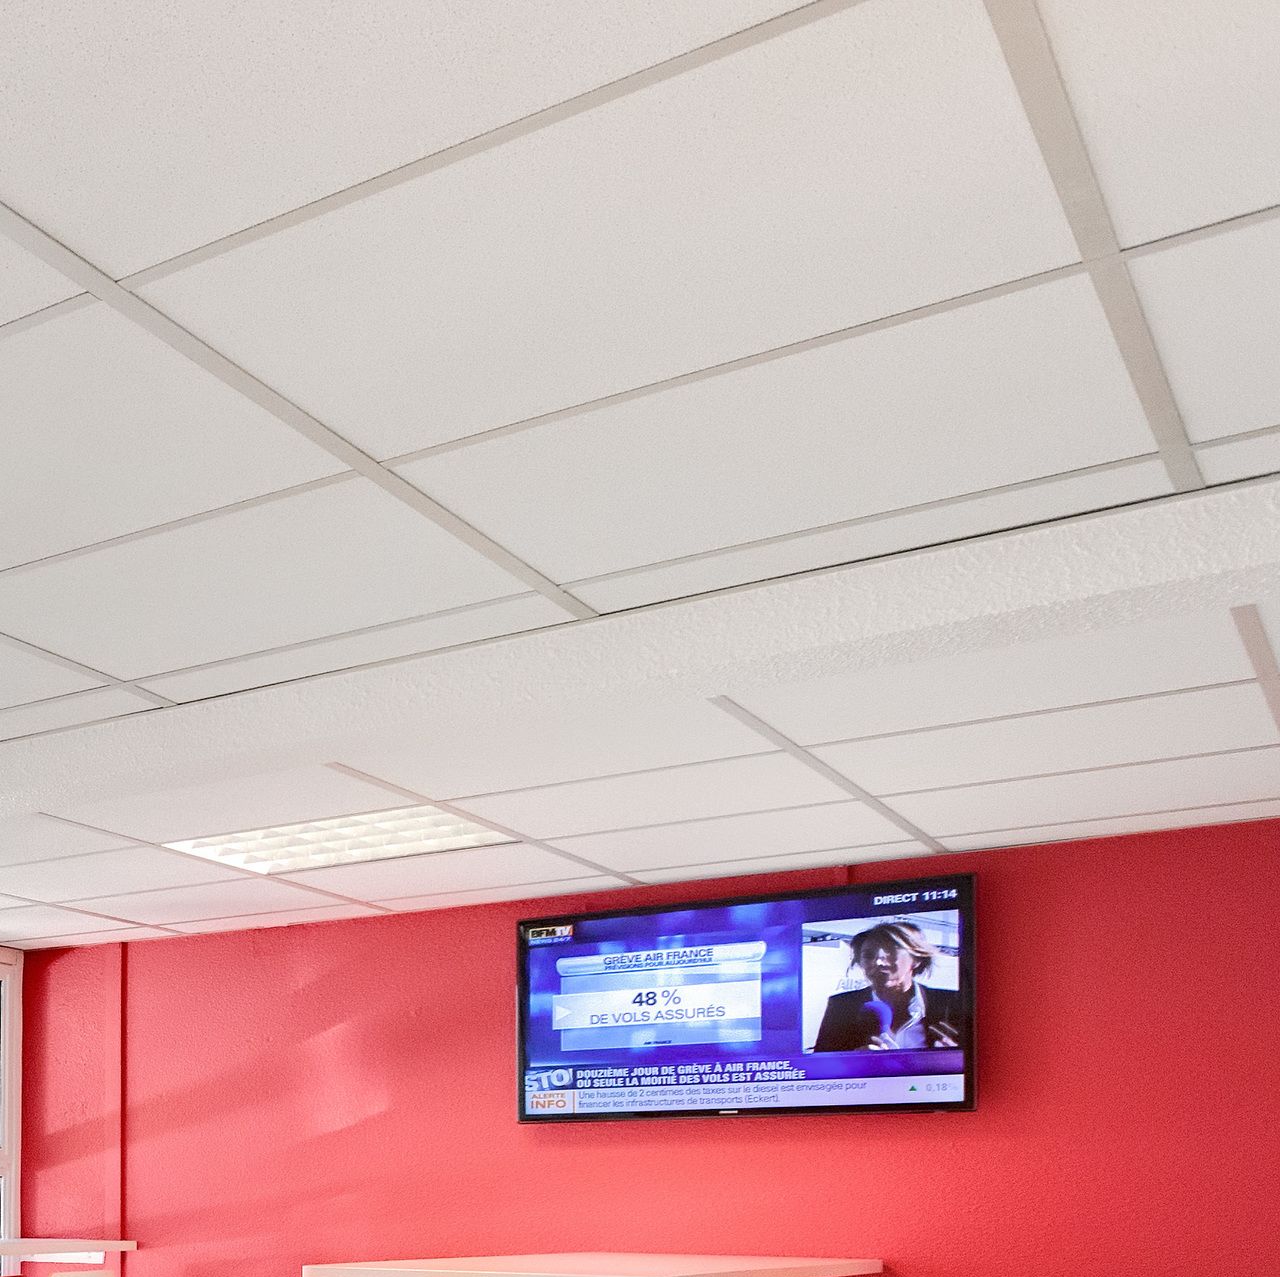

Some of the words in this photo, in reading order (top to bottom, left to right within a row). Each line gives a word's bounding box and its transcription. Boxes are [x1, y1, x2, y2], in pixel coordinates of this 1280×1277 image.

[873, 892, 919, 906] DIRECT
[921, 889, 958, 901] 11:14
[644, 952, 664, 962] AIR
[665, 948, 714, 961] FRANCE
[632, 991, 658, 1007] 48
[660, 989, 682, 1006] %
[590, 1013, 609, 1025] DE
[612, 1011, 651, 1023] VOLS
[654, 1004, 726, 1021] ASSURÉS
[576, 1067, 629, 1079] DOUZIÈME
[630, 1066, 659, 1077] JOUR
[661, 1065, 676, 1076] DE
[677, 1062, 713, 1074] GRÈVE
[713, 1062, 723, 1073] À
[724, 1062, 744, 1073] AIR
[746, 1060, 794, 1072] FRANCE,
[592, 1077, 625, 1088] SEULE
[625, 1076, 640, 1086] LA
[640, 1074, 678, 1086] MOITIÉ
[679, 1074, 701, 1084] DES
[701, 1072, 730, 1083] VOLS
[731, 1072, 753, 1082] EST
[754, 1068, 807, 1081] ASSURÉE
[530, 1092, 566, 1100] ALERTE
[578, 1089, 596, 1100] Une
[596, 1088, 626, 1099] hausse
[627, 1087, 639, 1098] de
[639, 1088, 645, 1098] 2
[646, 1086, 684, 1098] centimes
[685, 1085, 701, 1096] des
[702, 1085, 727, 1095] taxes
[727, 1086, 741, 1094] sur
[743, 1083, 752, 1093] le
[780, 1082, 795, 1092] est
[796, 1080, 843, 1092] envisagée
[844, 1081, 867, 1092] pour
[530, 1099, 567, 1109] INFO
[612, 1098, 625, 1108] les
[688, 1095, 699, 1105] de
[699, 1094, 744, 1106] transports
